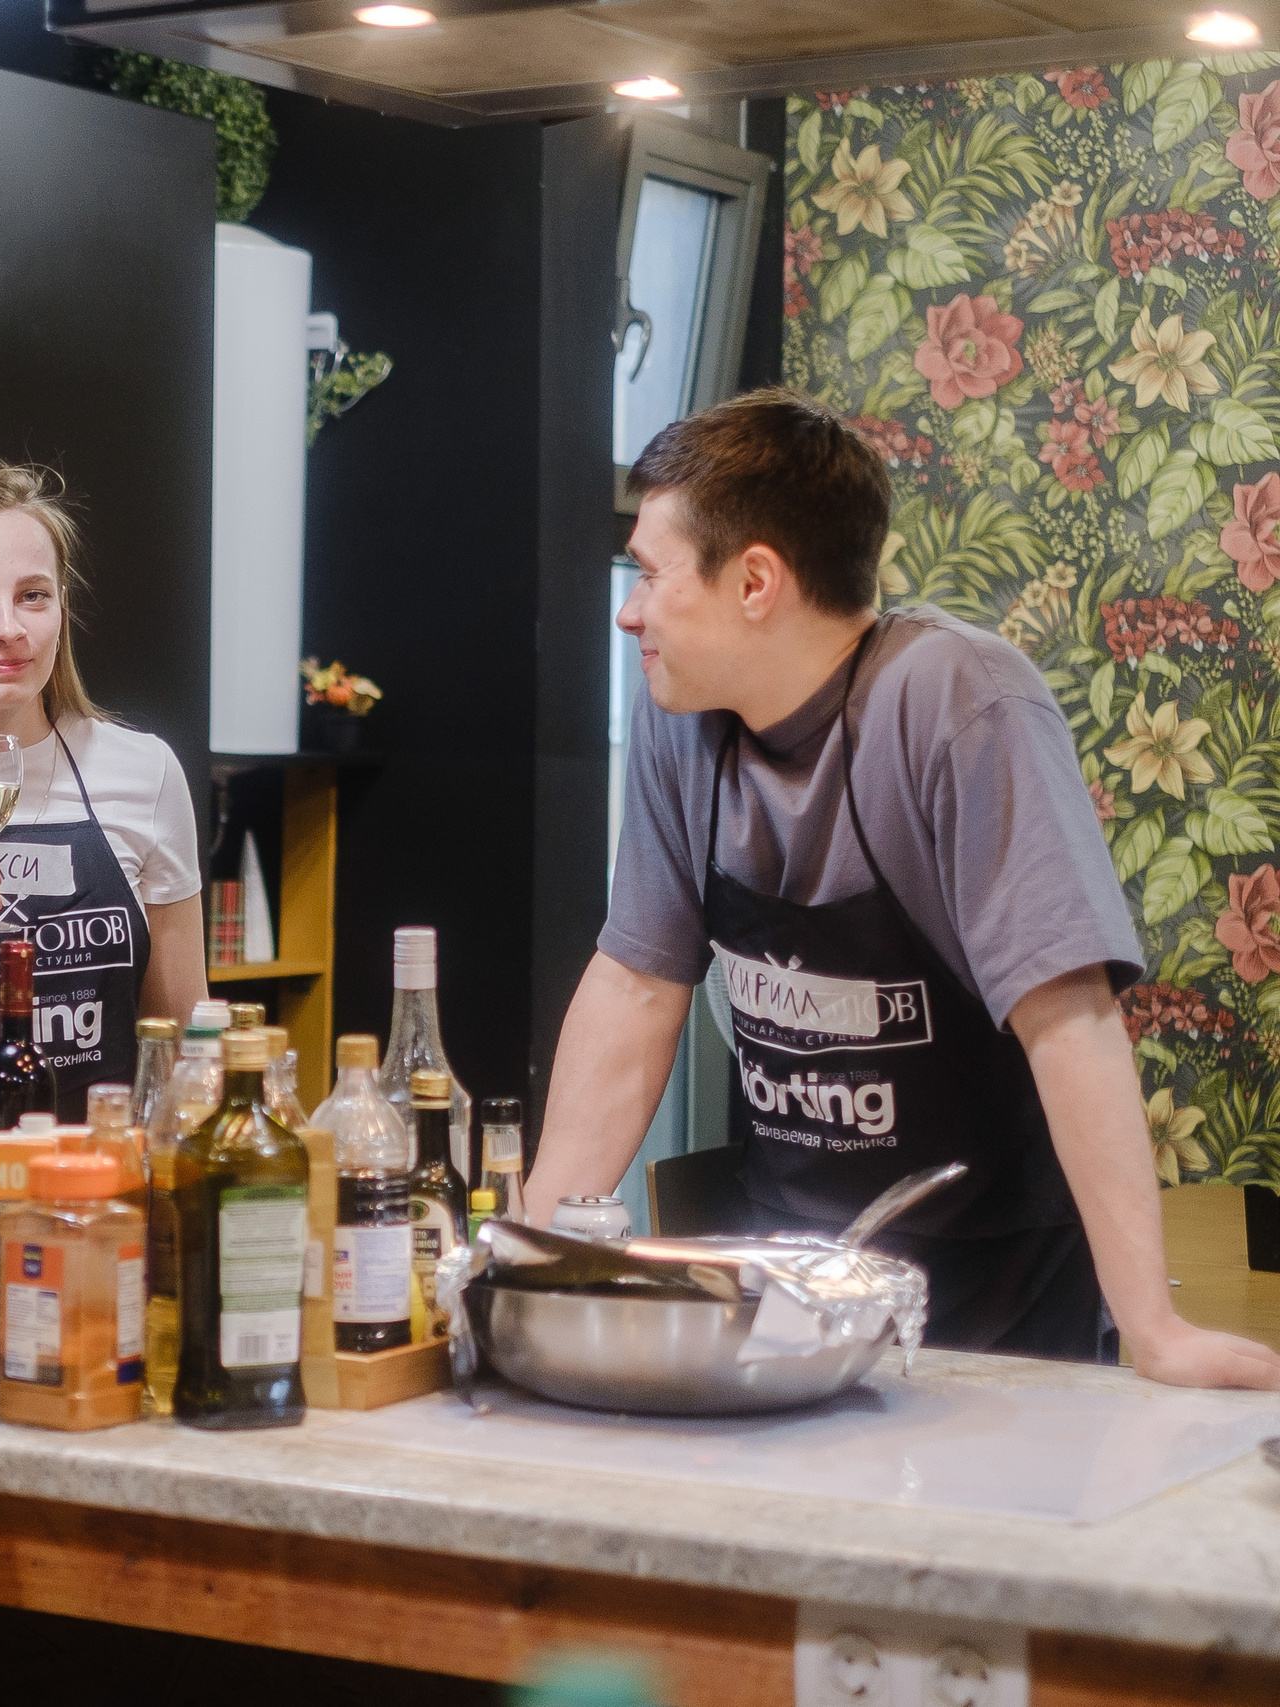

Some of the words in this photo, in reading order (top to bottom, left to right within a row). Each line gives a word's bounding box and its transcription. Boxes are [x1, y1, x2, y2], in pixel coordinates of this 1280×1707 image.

[35, 952, 93, 968] СТУДИЯ
[39, 992, 67, 1004] since
[70, 988, 97, 1001] 1889
[726, 957, 821, 1020] КИРИЛЛ
[738, 1046, 896, 1135] körting
[824, 1135, 898, 1152] техника
